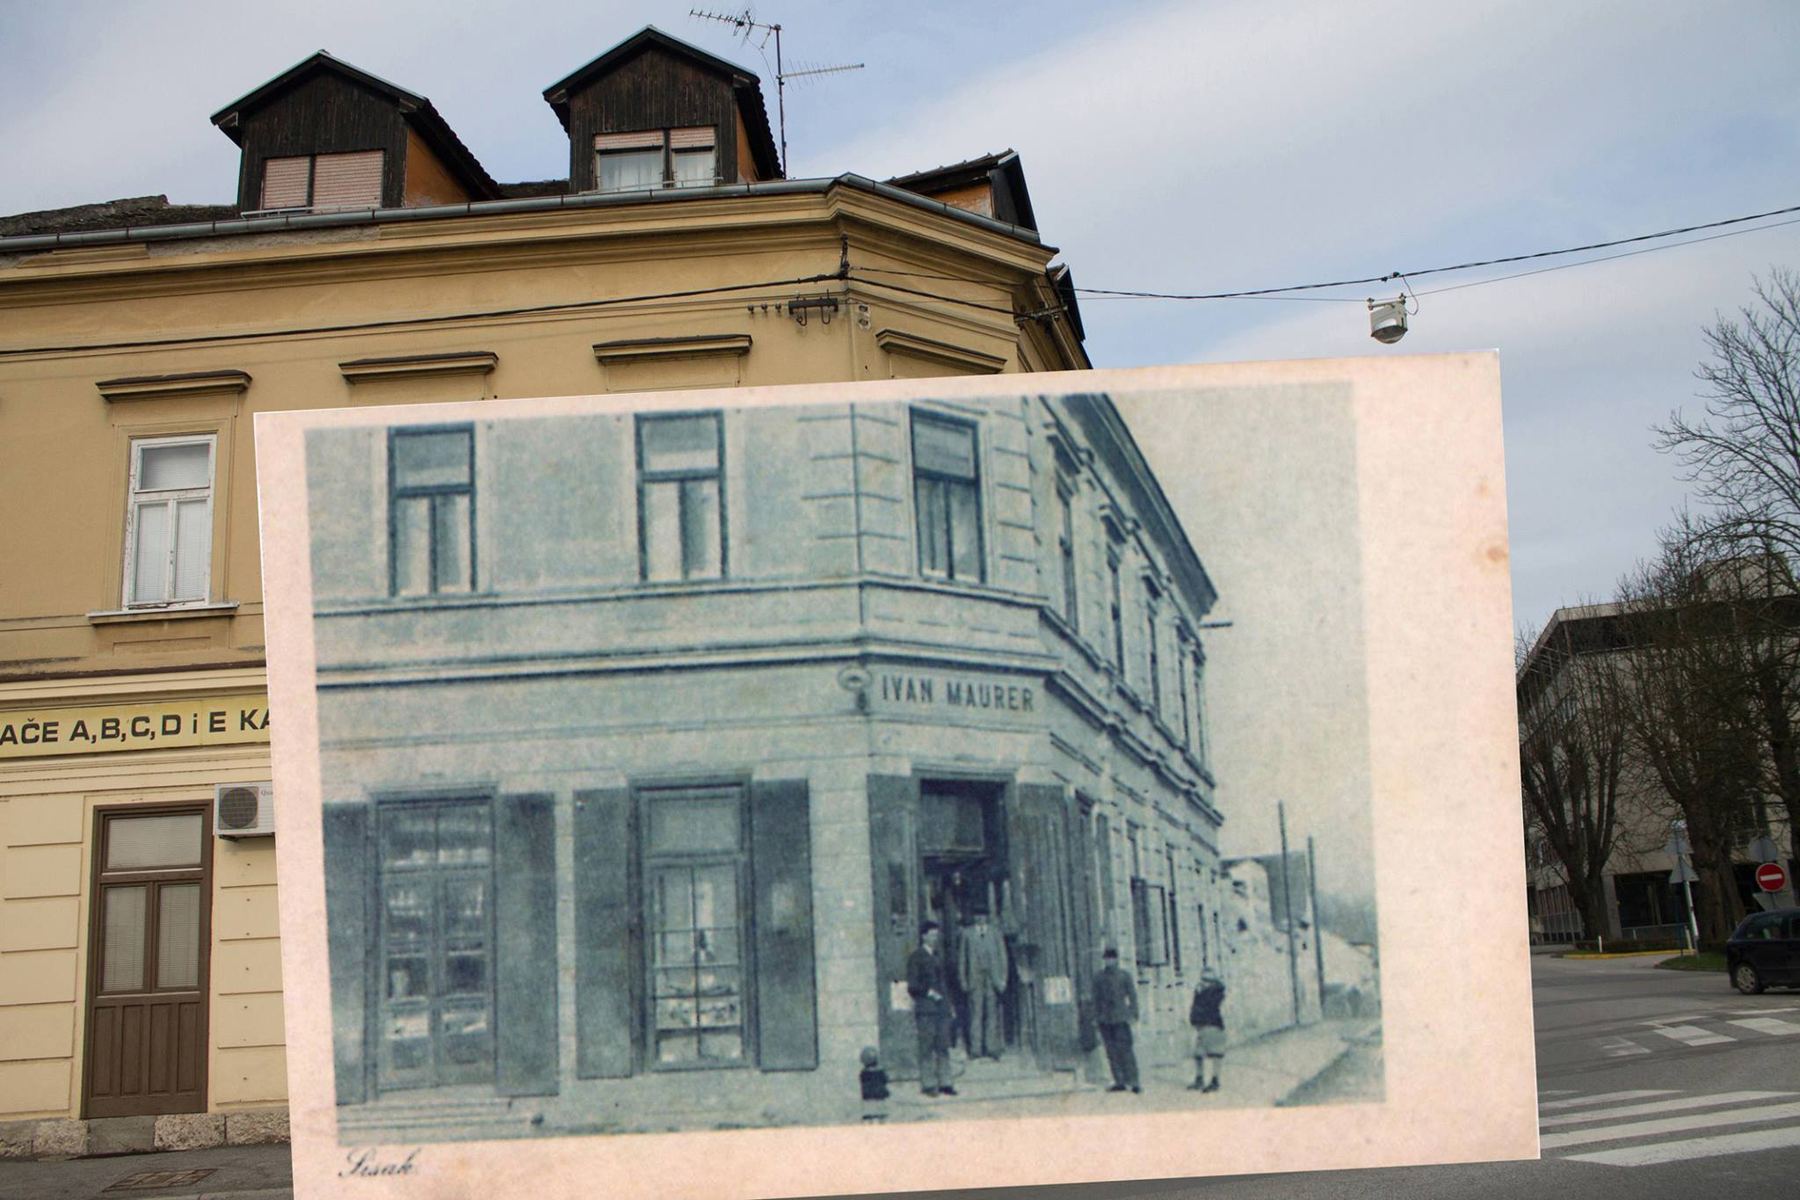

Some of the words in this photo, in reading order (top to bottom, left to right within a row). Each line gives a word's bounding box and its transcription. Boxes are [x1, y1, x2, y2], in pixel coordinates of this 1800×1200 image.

[882, 675, 933, 703] IVAN
[947, 681, 1034, 712] MAURER
[192, 713, 198, 734] i
[209, 711, 226, 733] E
